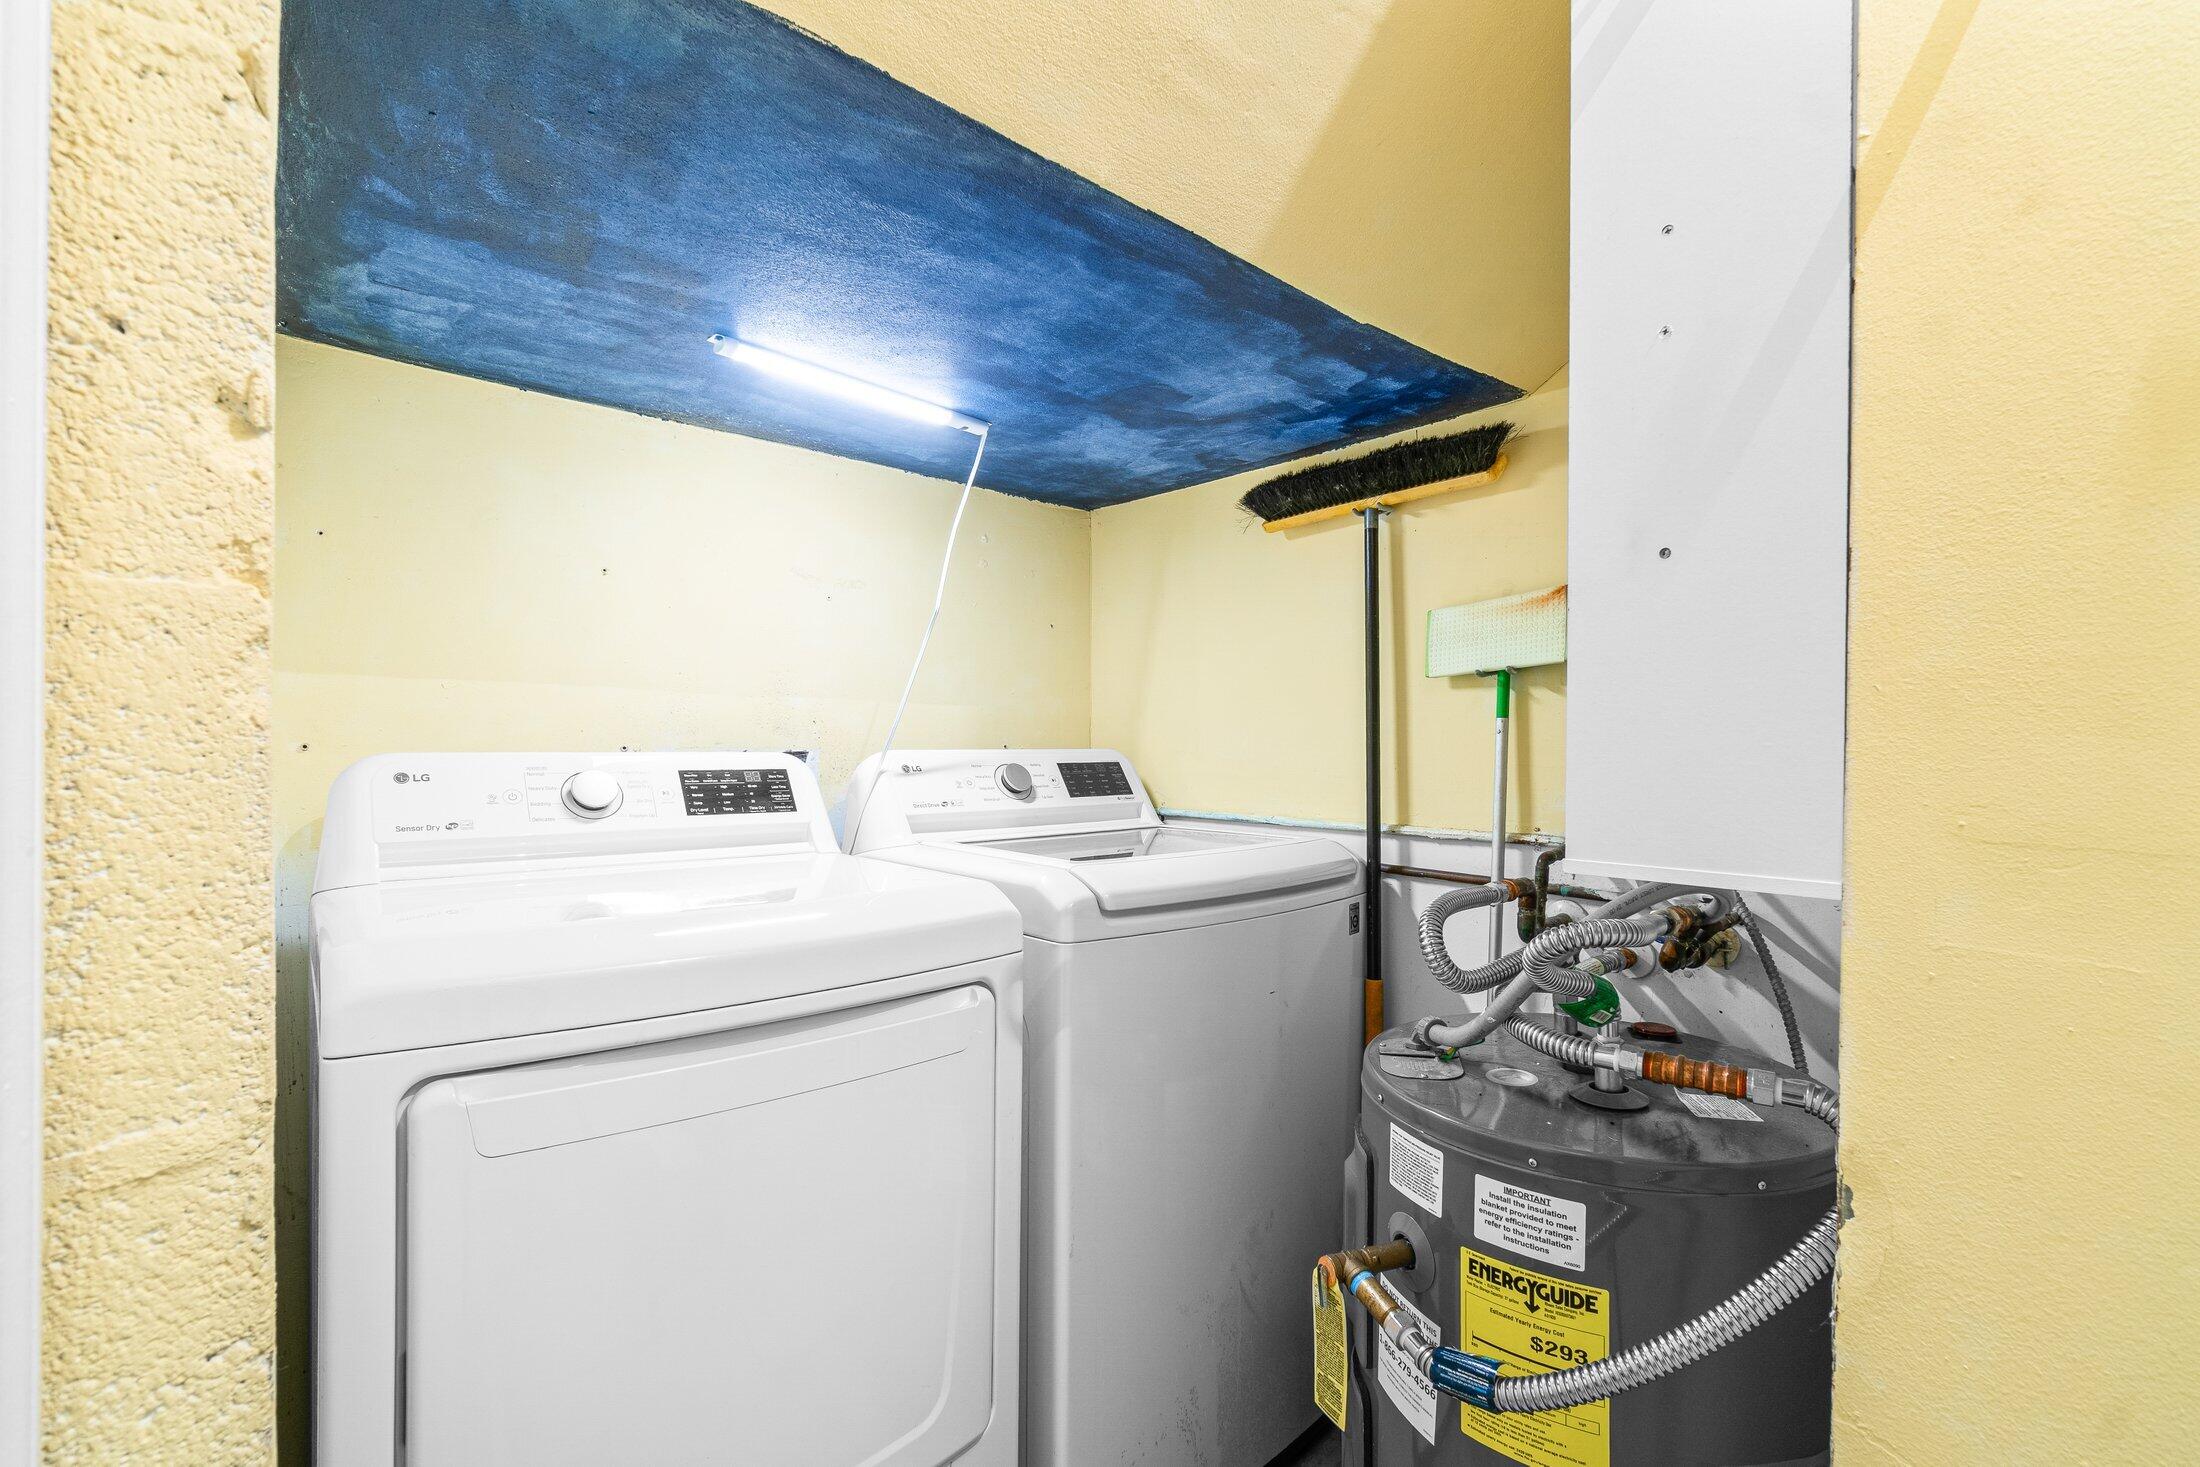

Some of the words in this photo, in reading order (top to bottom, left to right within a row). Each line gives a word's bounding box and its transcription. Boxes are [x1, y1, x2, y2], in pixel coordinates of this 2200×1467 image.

[412, 773, 431, 783] LG
[910, 765, 923, 773] LG
[395, 825, 424, 833] Sensor
[426, 824, 441, 833] Dry
[1488, 1191, 1512, 1205] Install
[1512, 1199, 1526, 1210] the
[1527, 1203, 1568, 1221] insulation
[1503, 1186, 1552, 1207] IMPORTANT
[1478, 1207, 1504, 1222] energy
[1504, 1215, 1544, 1235] efficiency
[1544, 1228, 1575, 1243] ratings
[1480, 1198, 1508, 1213] blanket
[1509, 1207, 1545, 1224] provided
[1545, 1218, 1555, 1228] to
[1556, 1222, 1578, 1233] meet
[1484, 1218, 1502, 1230] refer
[1503, 1224, 1512, 1234] to
[1512, 1227, 1526, 1238] the
[1526, 1231, 1573, 1251] installation
[1388, 1288, 1400, 1303] NOT
[1400, 1300, 1422, 1326] RETURN
[1422, 1320, 1438, 1338] THIS
[1489, 1307, 1514, 1322] Estimated
[1514, 1316, 1532, 1329] Yearly
[1532, 1323, 1552, 1335] Energy
[1552, 1329, 1566, 1338] Cost
[1529, 1335, 1590, 1366] $293
